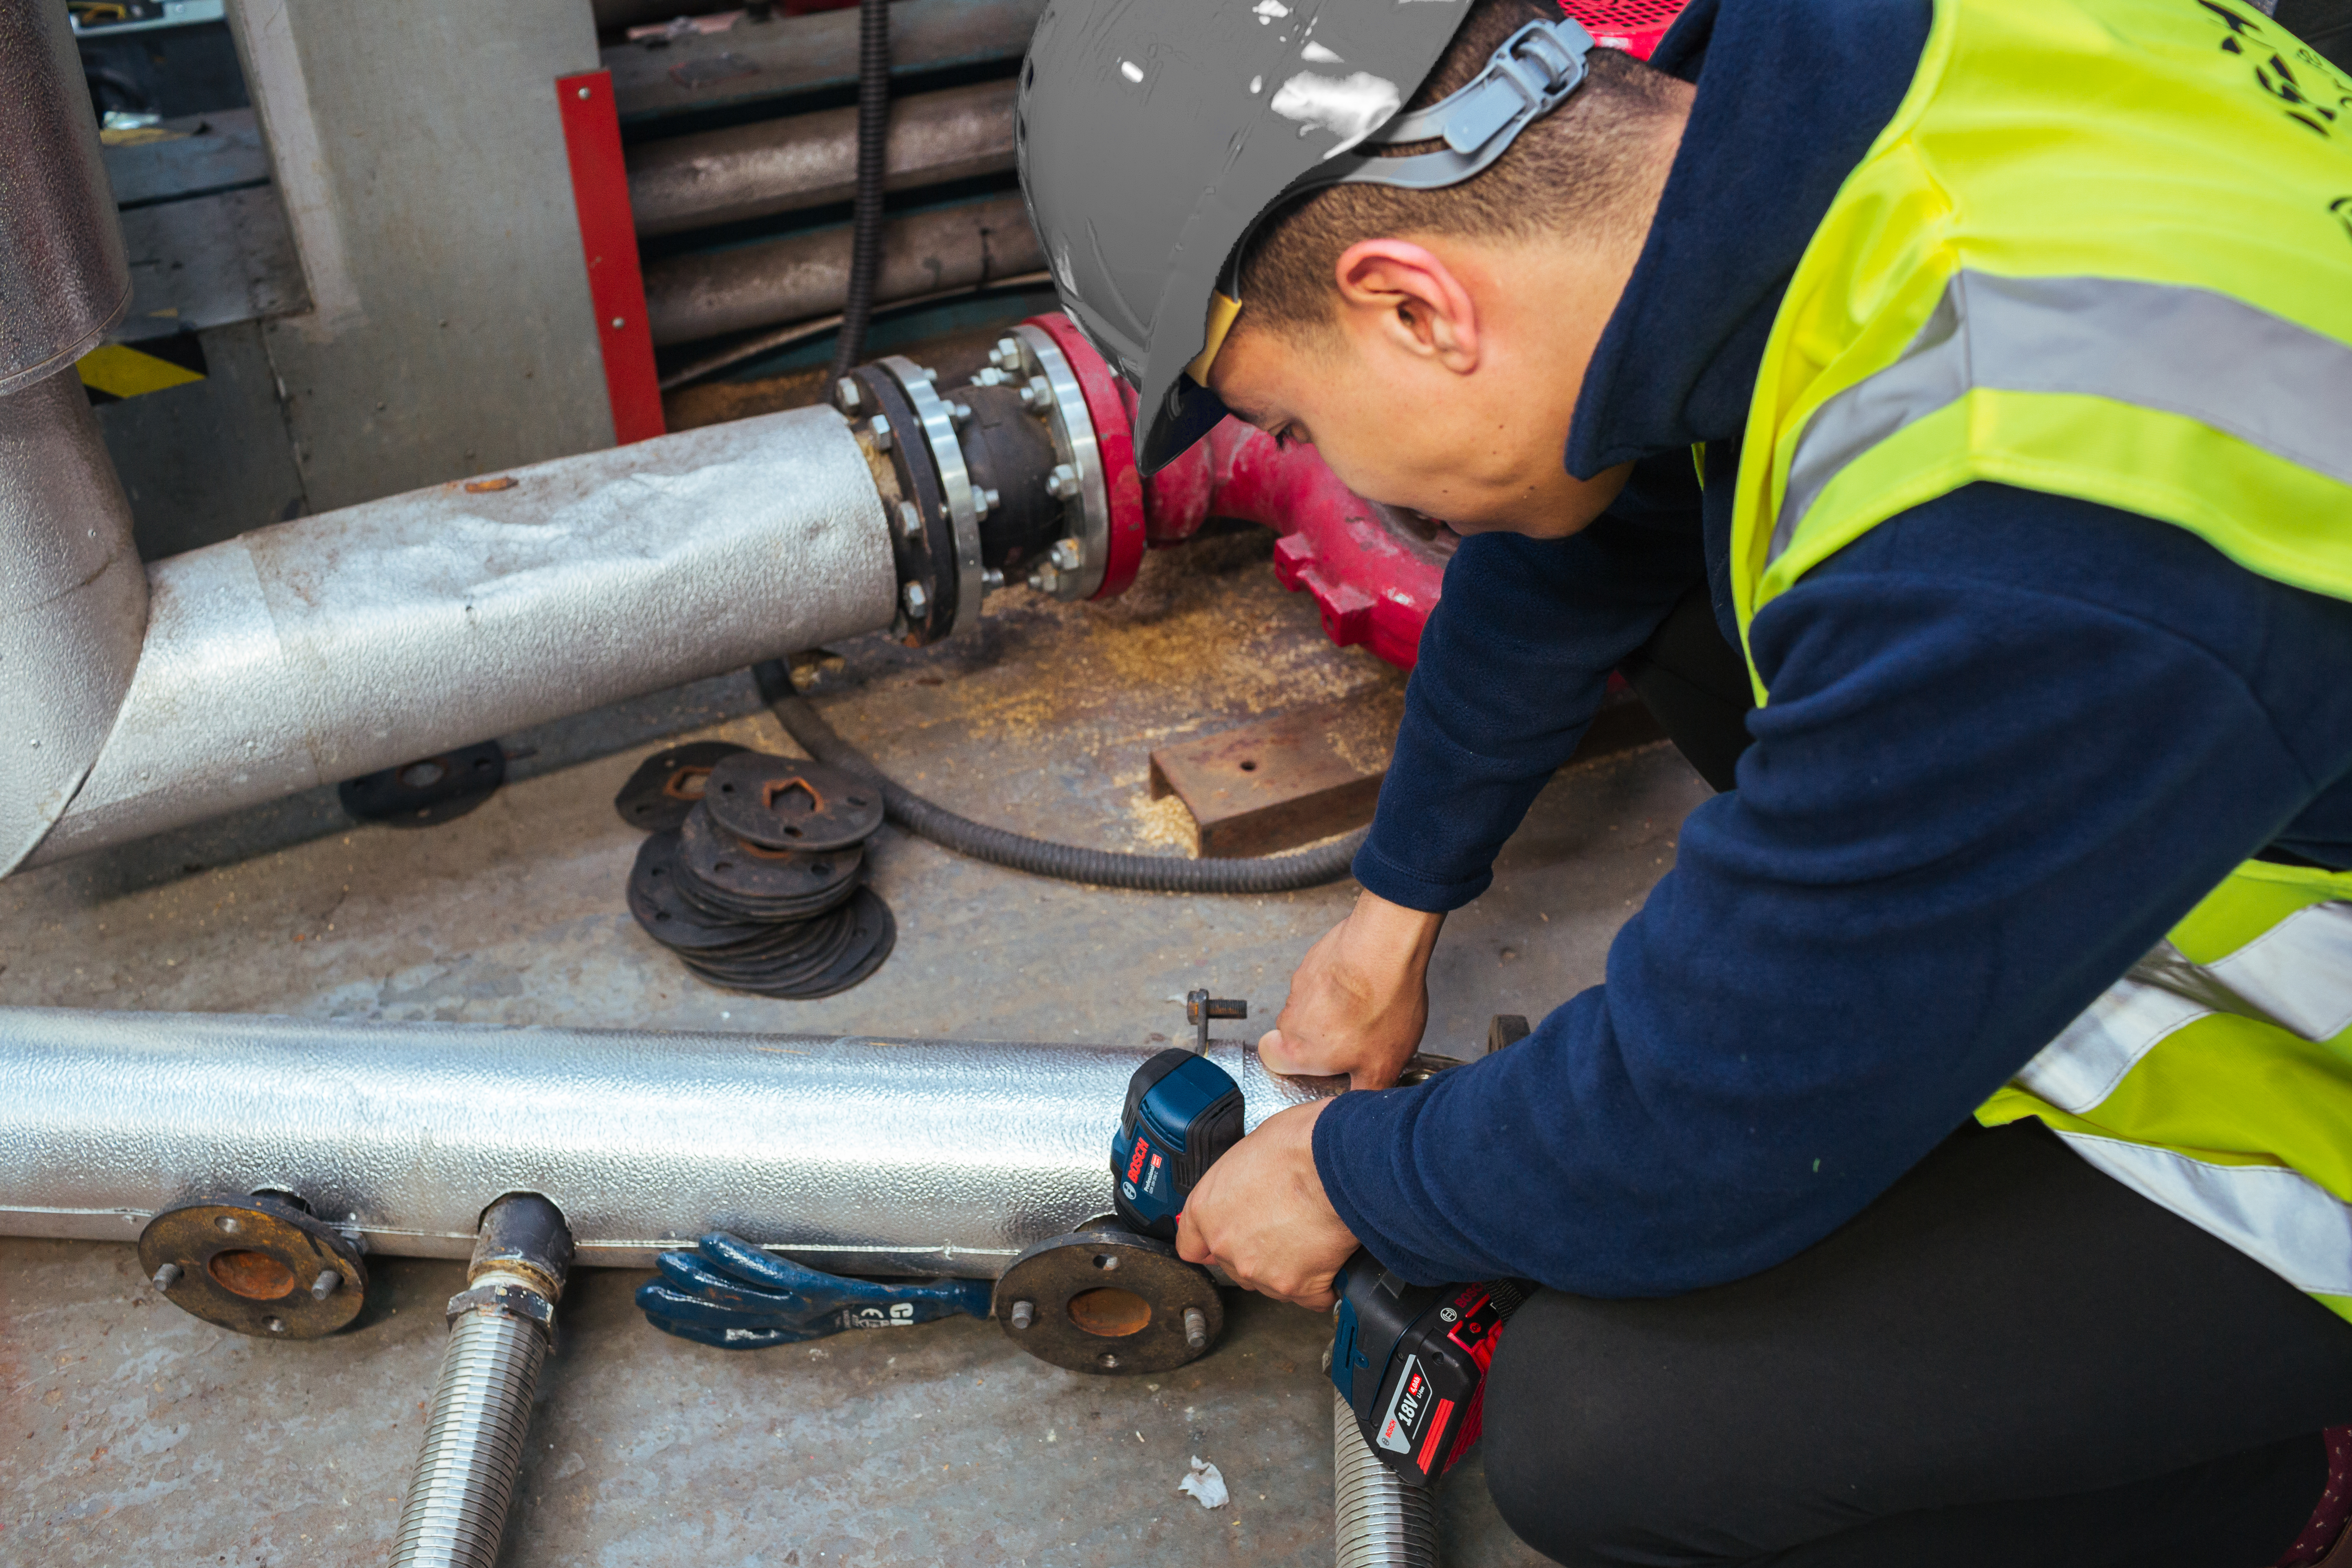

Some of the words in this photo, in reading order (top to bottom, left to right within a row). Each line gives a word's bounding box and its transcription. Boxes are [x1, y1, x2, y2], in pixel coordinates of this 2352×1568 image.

[1127, 1137, 1149, 1184] BOSCH
[1144, 1164, 1155, 1192] Professional
[1454, 1282, 1483, 1308] BOSC
[1410, 1376, 1421, 1393] 4,0Ah
[1398, 1392, 1418, 1426] 18V
[1385, 1418, 1396, 1439] BOSCH
